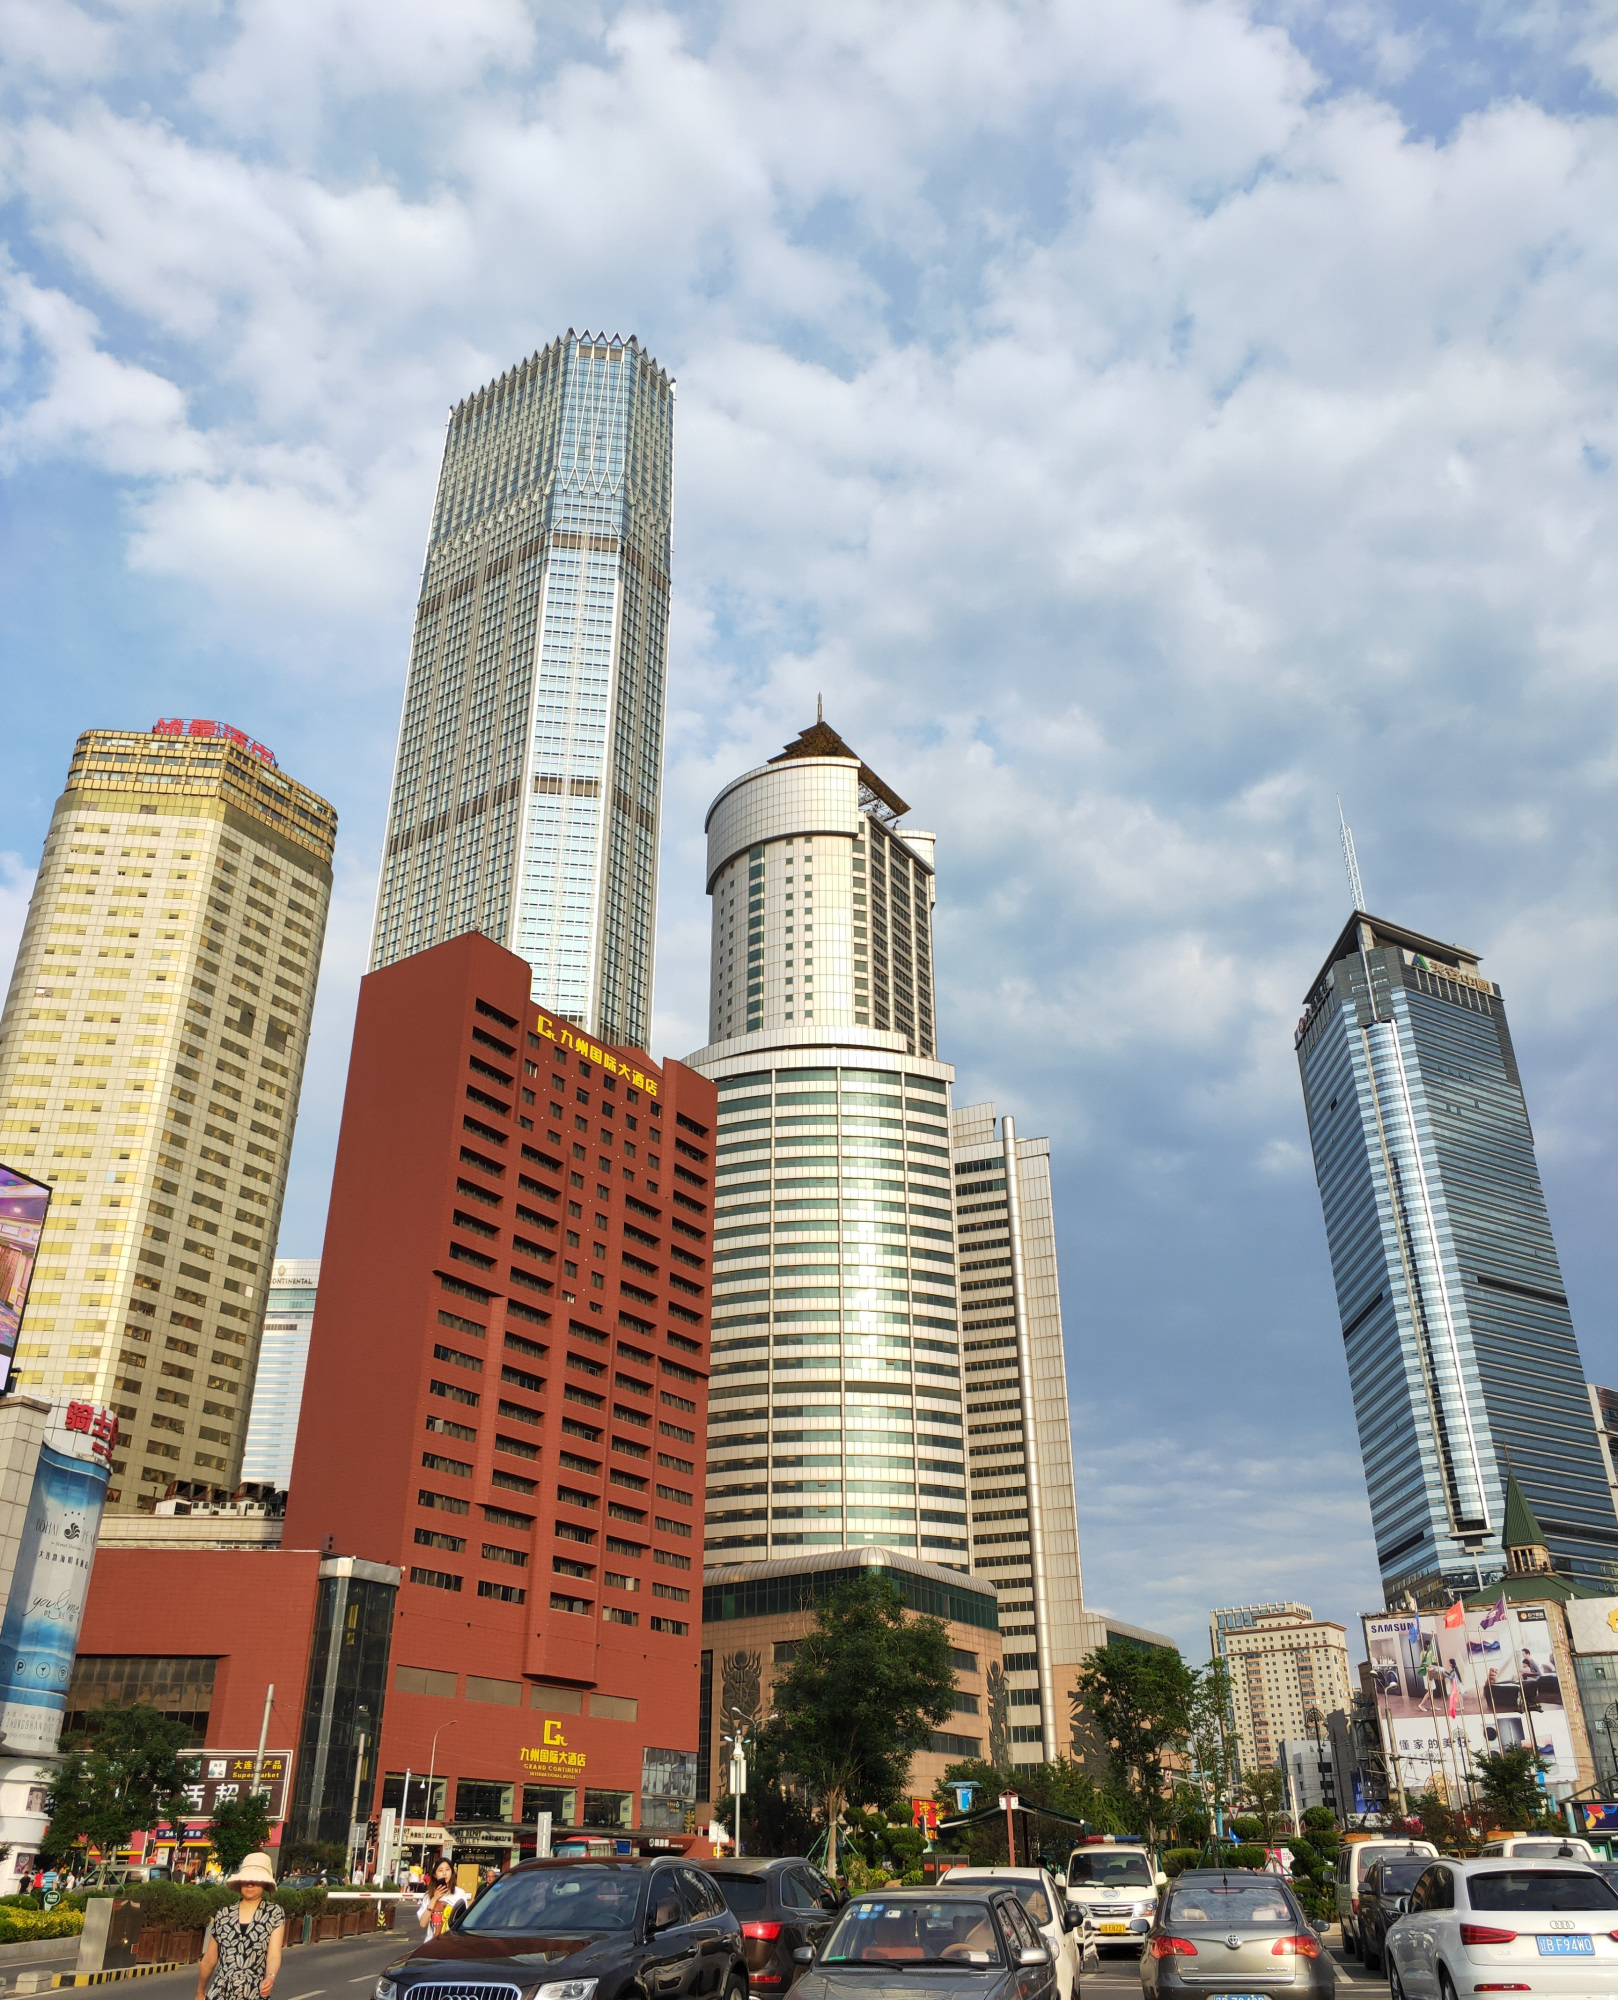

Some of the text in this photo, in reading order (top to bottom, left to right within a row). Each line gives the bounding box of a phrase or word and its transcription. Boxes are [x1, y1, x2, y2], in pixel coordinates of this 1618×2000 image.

[560, 1029, 658, 1097] 九州国际大酒店
[1371, 1621, 1414, 1634] SAMSUN
[520, 1747, 587, 1767] 九州国际大酒店
[232, 1771, 280, 1779] Superarket
[523, 1763, 582, 1774] GRAND CONTINENT
